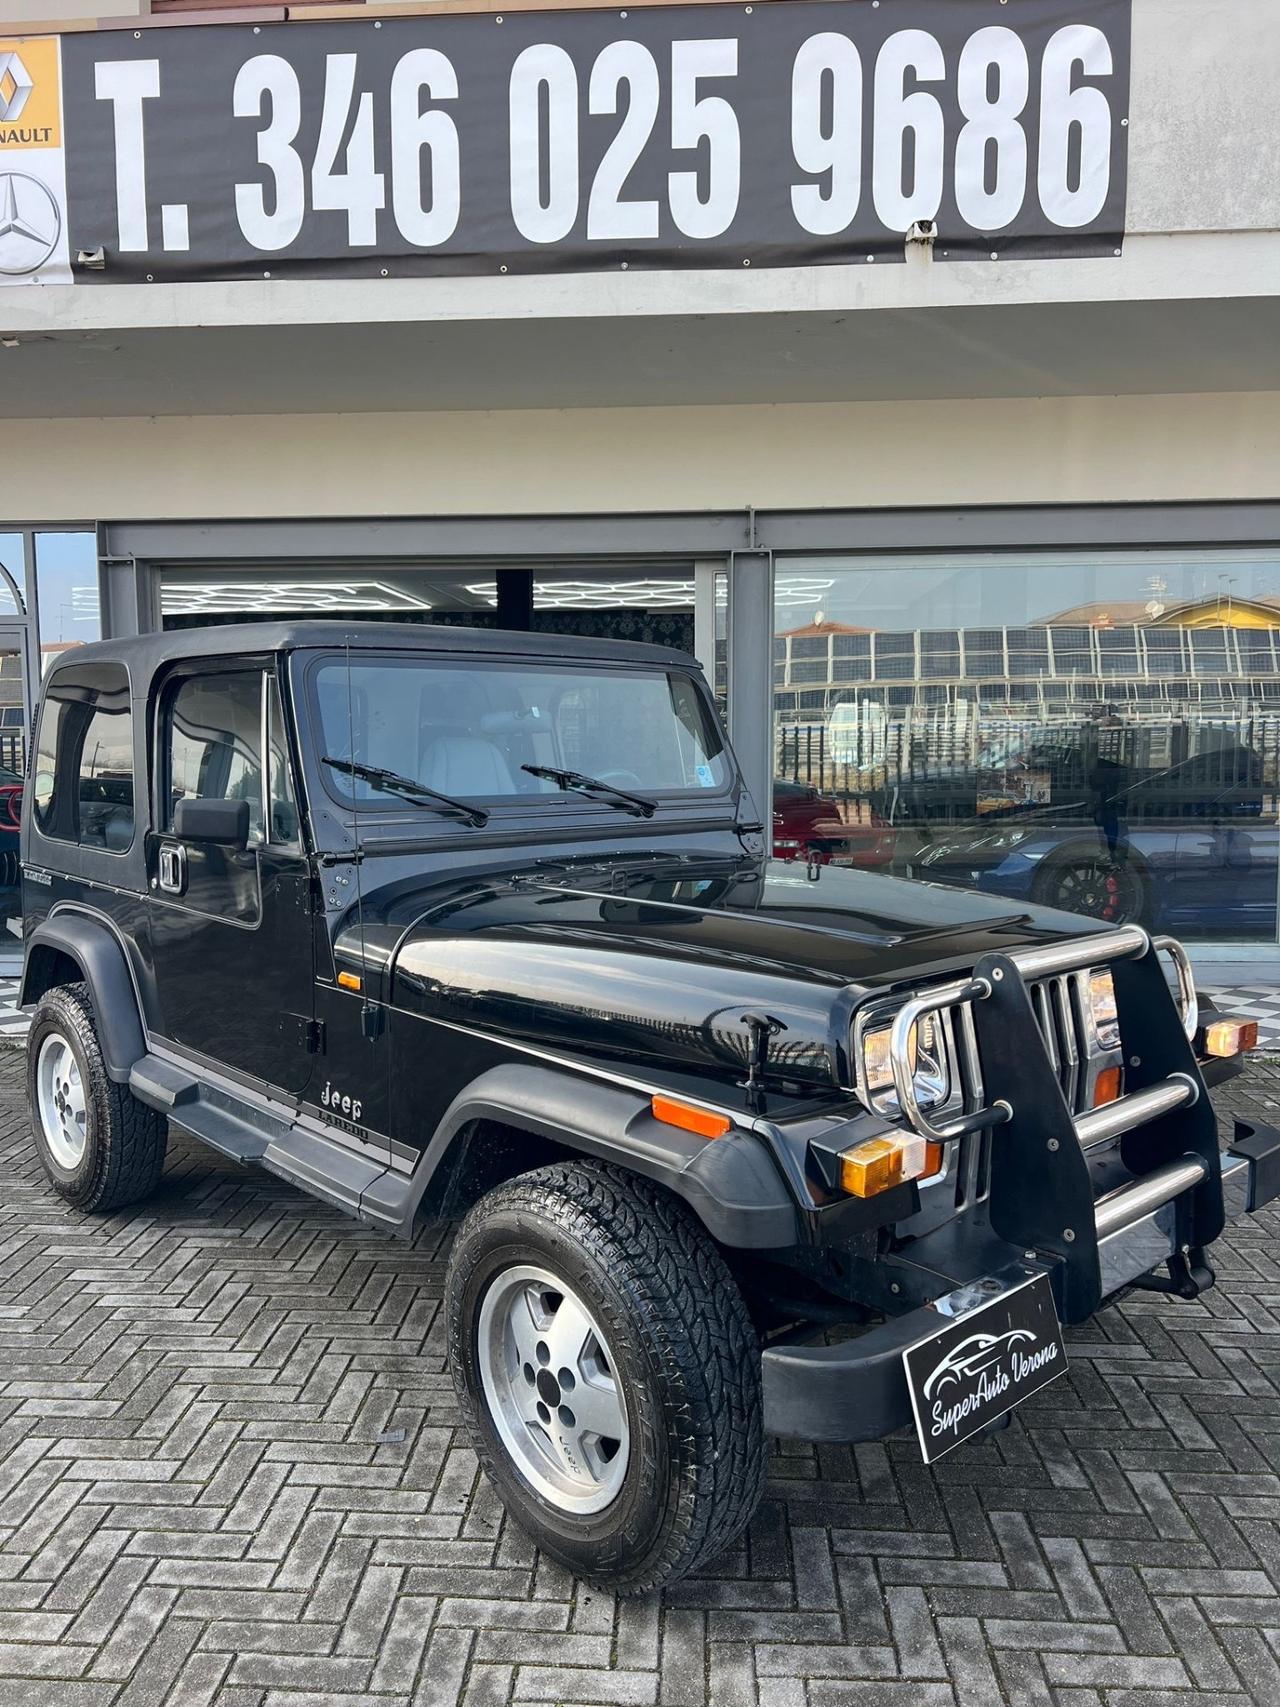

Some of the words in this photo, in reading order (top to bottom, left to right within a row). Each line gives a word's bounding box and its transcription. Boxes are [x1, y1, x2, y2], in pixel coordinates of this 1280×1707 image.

[93, 58, 191, 252] T.
[233, 48, 462, 251] 346
[508, 38, 741, 244] 025
[790, 23, 1114, 236] 9686
[931, 1364, 1011, 1437] SuperAuto
[1011, 1342, 1058, 1383] Verona
